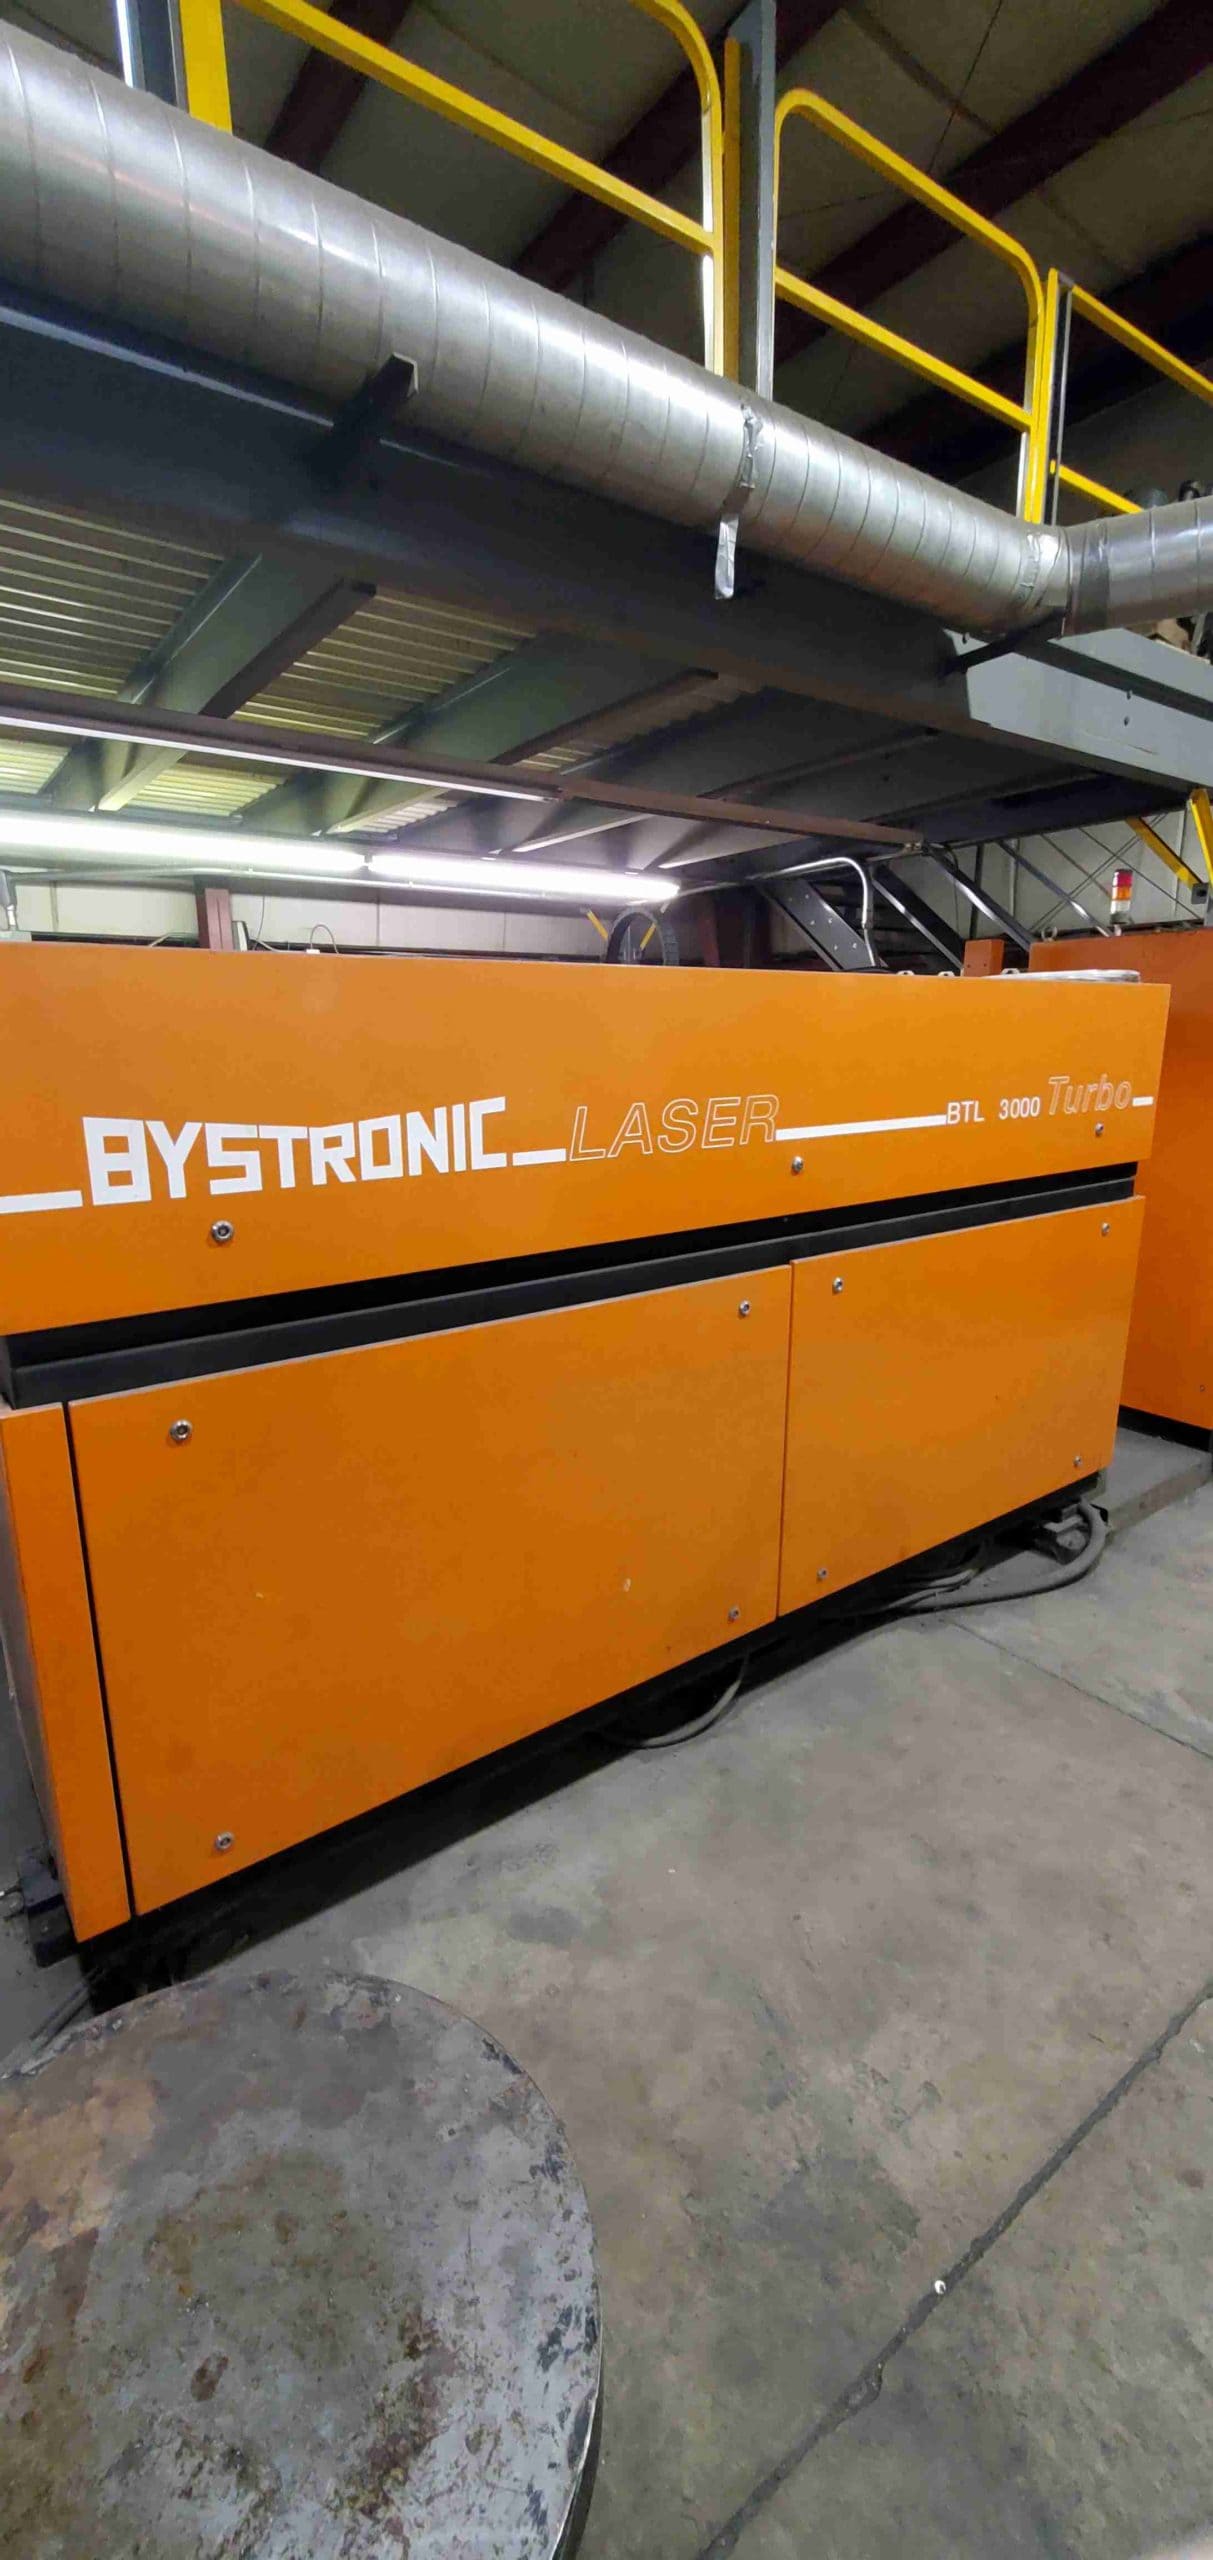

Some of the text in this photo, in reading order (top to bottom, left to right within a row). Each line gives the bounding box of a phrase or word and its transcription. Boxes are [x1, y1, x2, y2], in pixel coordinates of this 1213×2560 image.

[82, 1073, 1132, 1206] BYSTRONIC LASER BTL 3000 Turbo
